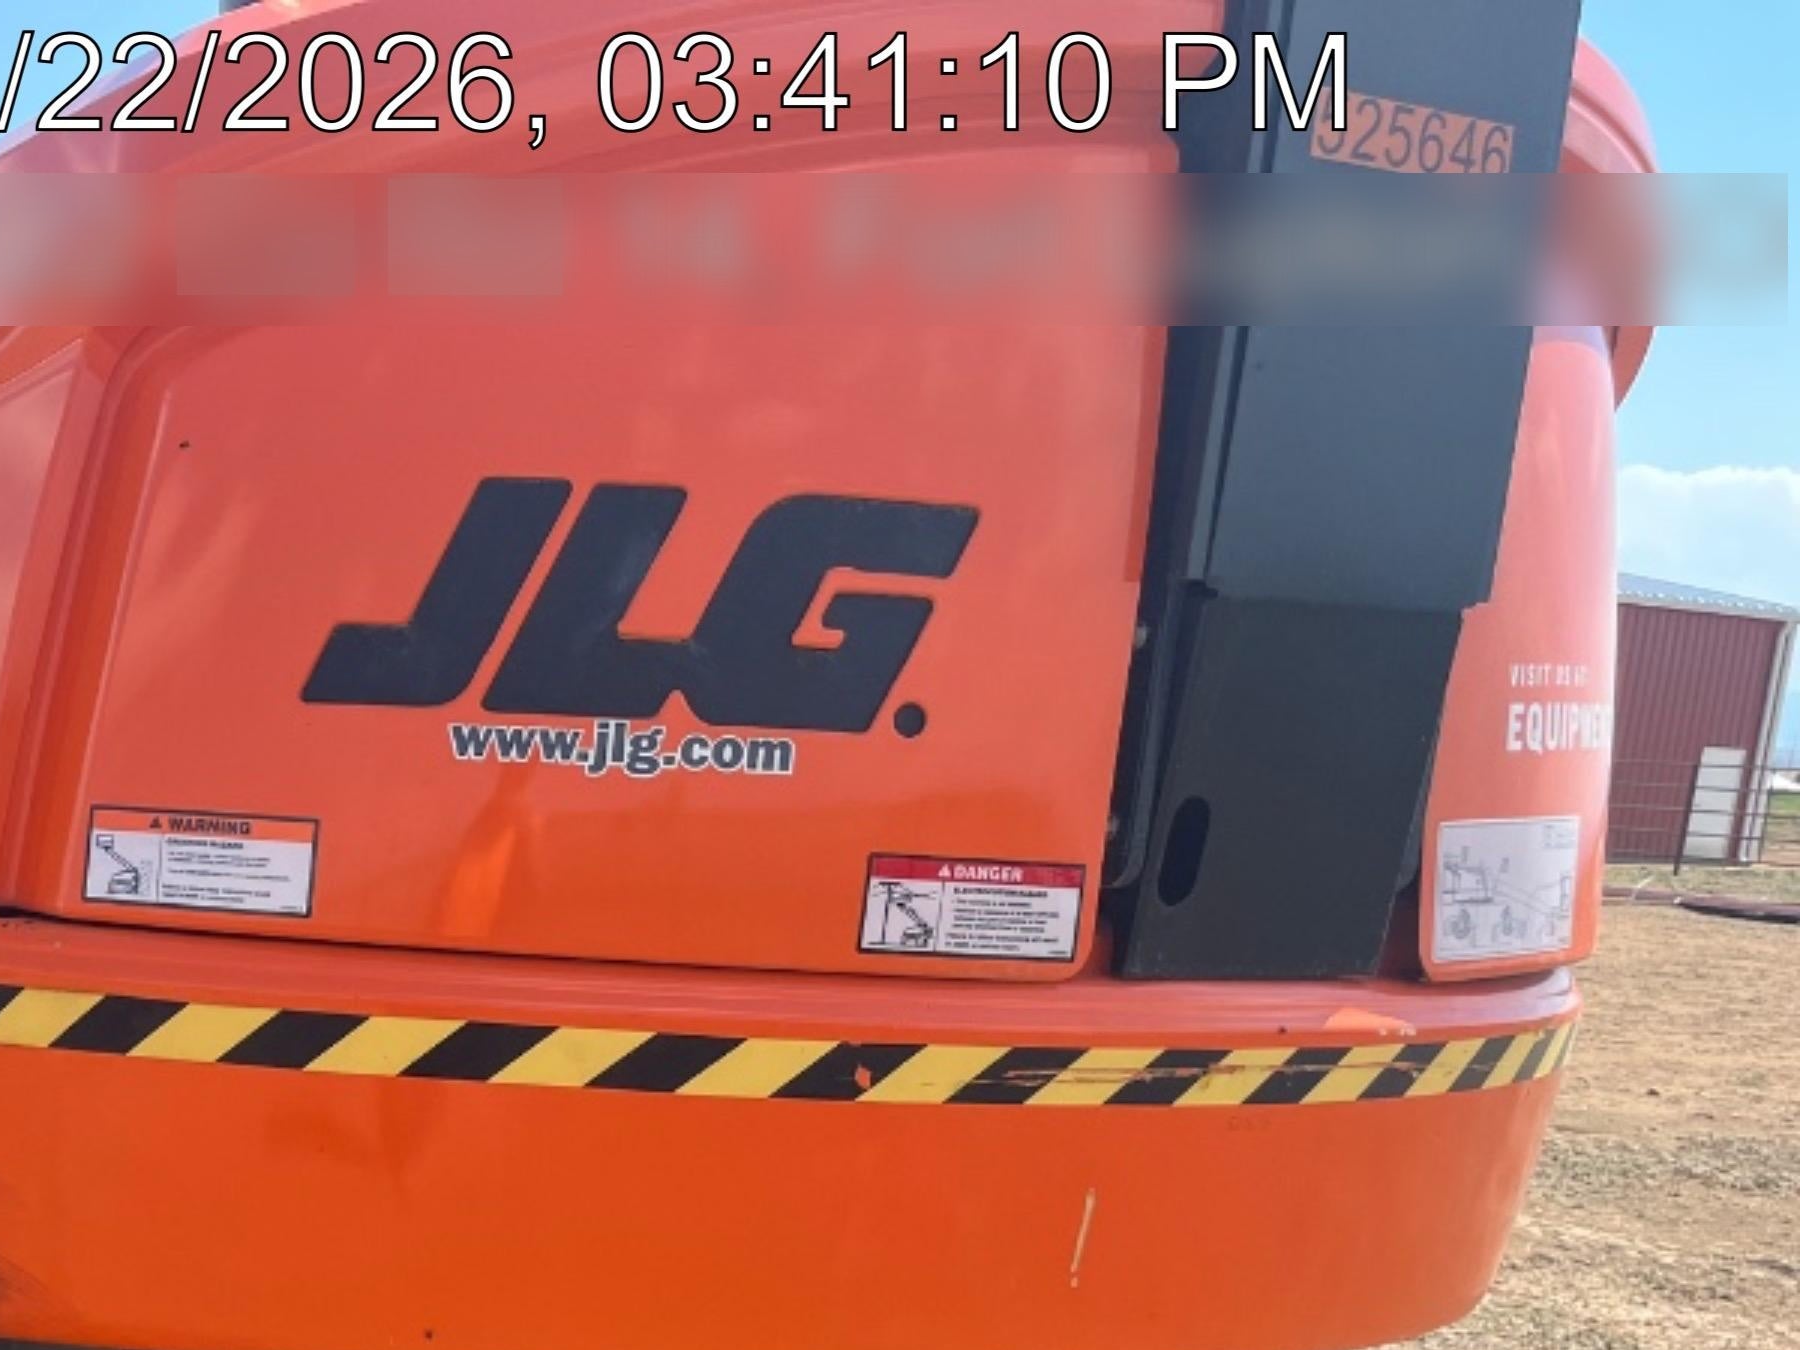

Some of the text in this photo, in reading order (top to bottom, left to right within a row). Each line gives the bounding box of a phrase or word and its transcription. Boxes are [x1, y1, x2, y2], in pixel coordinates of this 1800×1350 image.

[448, 718, 795, 778] www.jlg.com
[168, 817, 250, 835] WARNING
[954, 864, 1023, 882] DANGER
